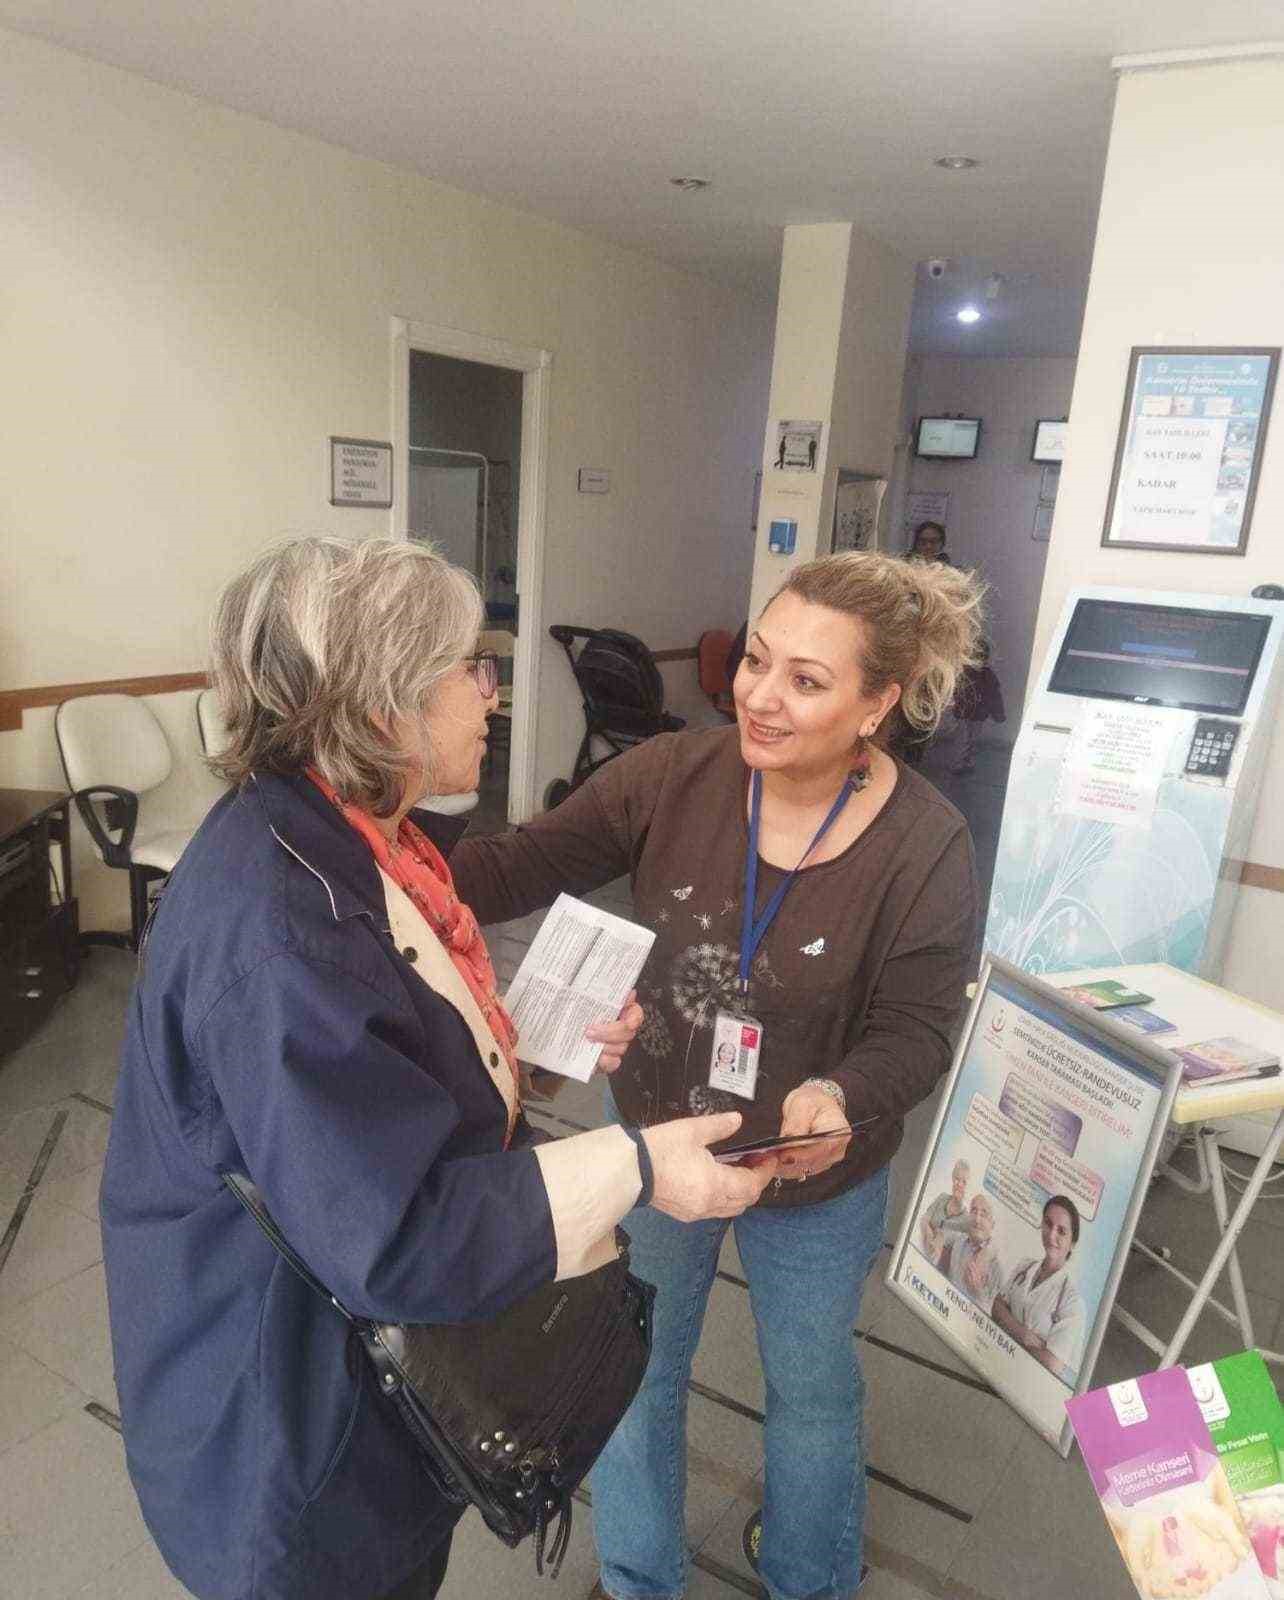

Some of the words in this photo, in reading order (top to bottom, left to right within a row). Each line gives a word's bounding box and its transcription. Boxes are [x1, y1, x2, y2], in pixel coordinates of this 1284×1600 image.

[1137, 477, 1178, 490] KADAR
[911, 1274, 950, 1319] KETEM
[997, 1334, 1017, 1359] BAK
[1113, 1467, 1147, 1487] Meme
[1147, 1451, 1192, 1475] Kanseri
